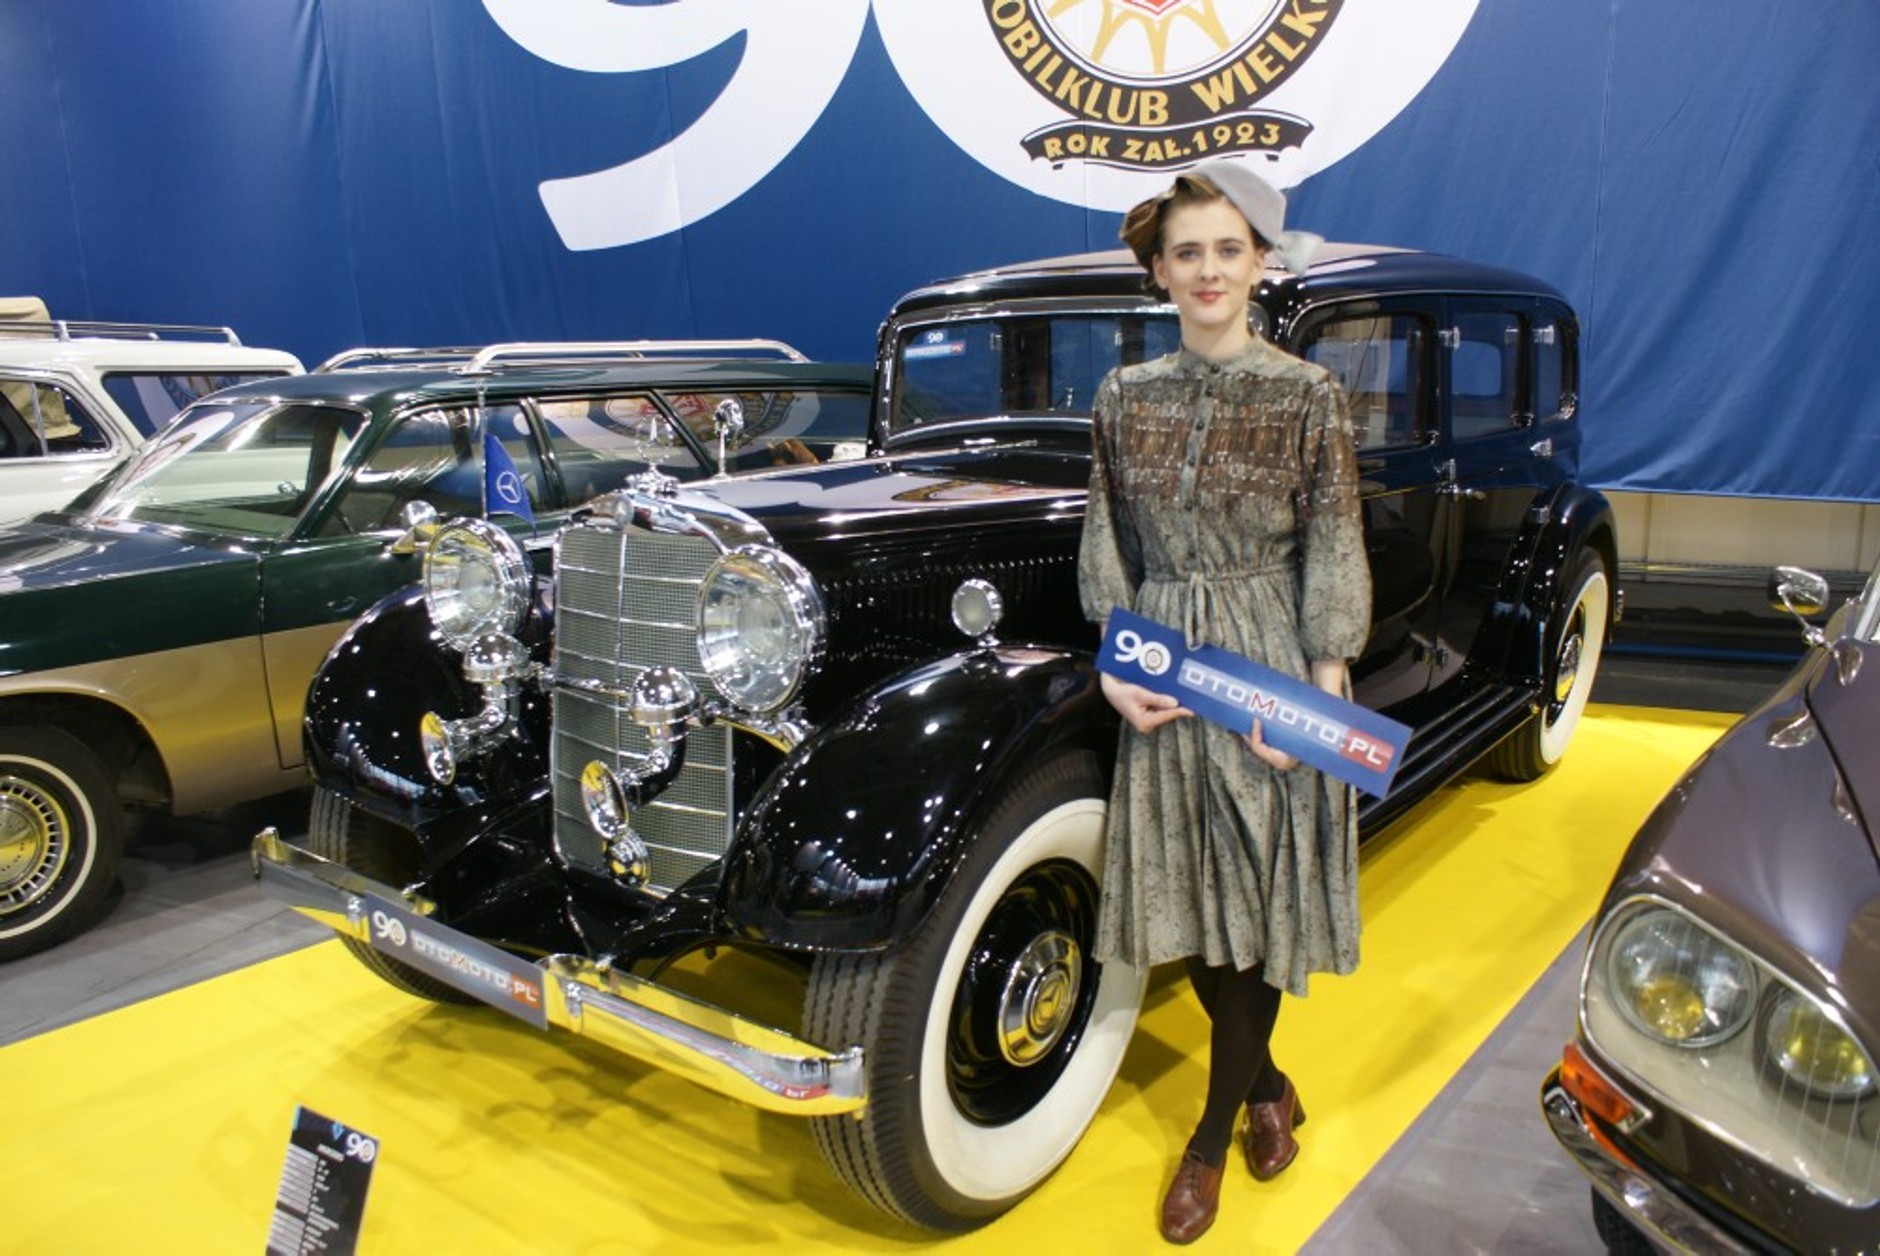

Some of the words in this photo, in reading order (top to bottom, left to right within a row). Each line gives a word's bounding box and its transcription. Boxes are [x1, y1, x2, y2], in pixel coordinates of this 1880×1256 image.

[1190, 0, 1328, 114] WIELK
[1043, 132, 1111, 158] ROK
[1114, 629, 1172, 676] 90
[373, 910, 407, 947] 90
[346, 1132, 376, 1163] 90
